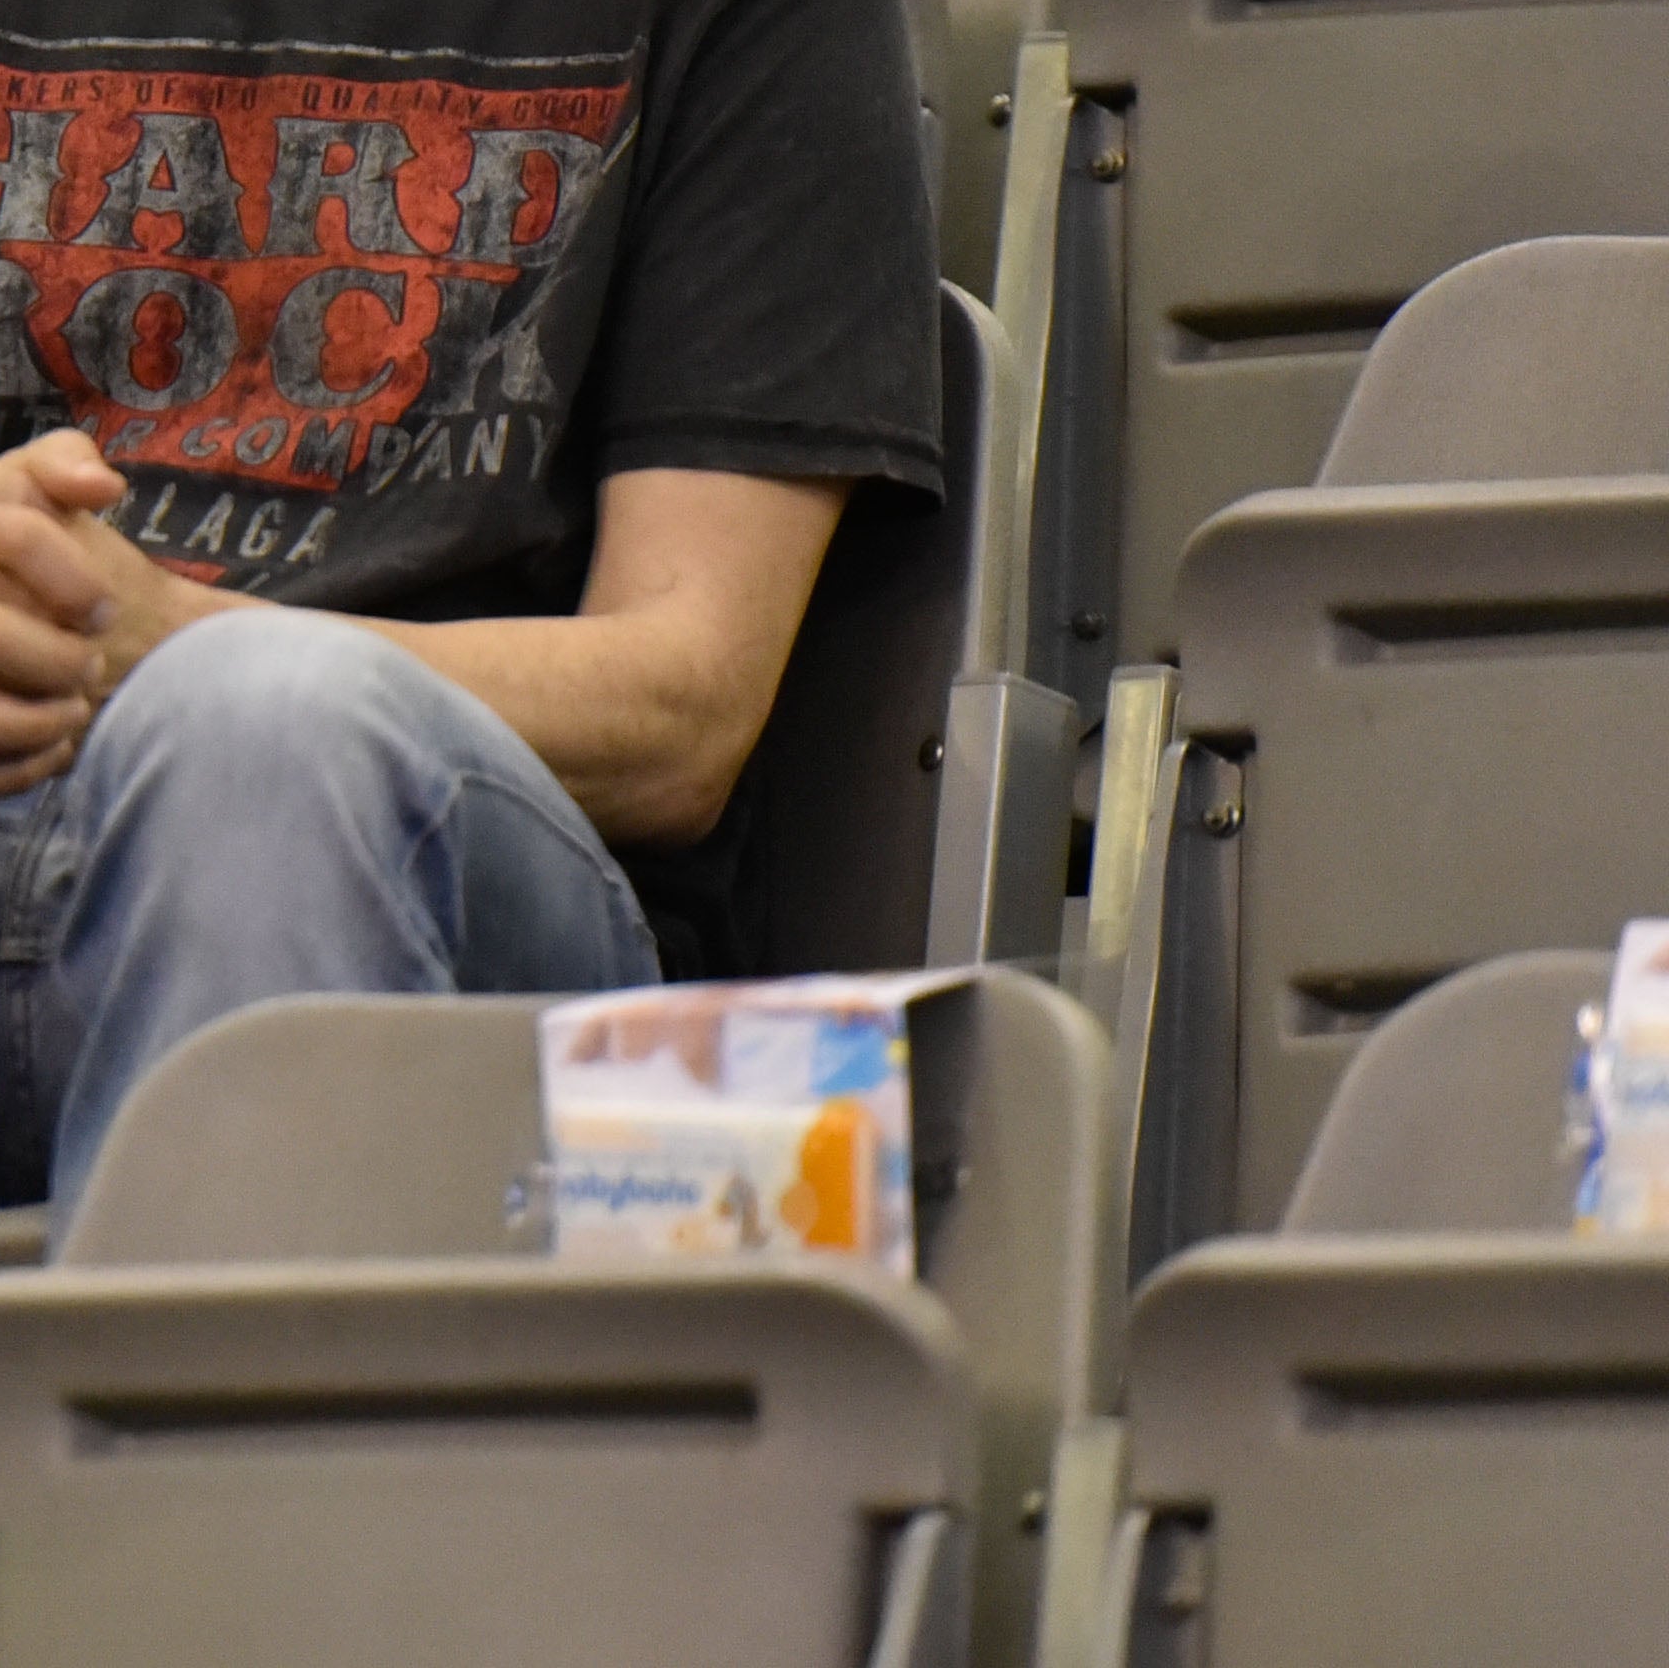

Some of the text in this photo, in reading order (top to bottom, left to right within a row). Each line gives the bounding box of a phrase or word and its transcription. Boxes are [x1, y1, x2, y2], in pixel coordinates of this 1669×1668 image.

[301, 82, 483, 121] QUALITY
[514, 90, 617, 122] GOOD
[180, 414, 556, 494] COMPANY
